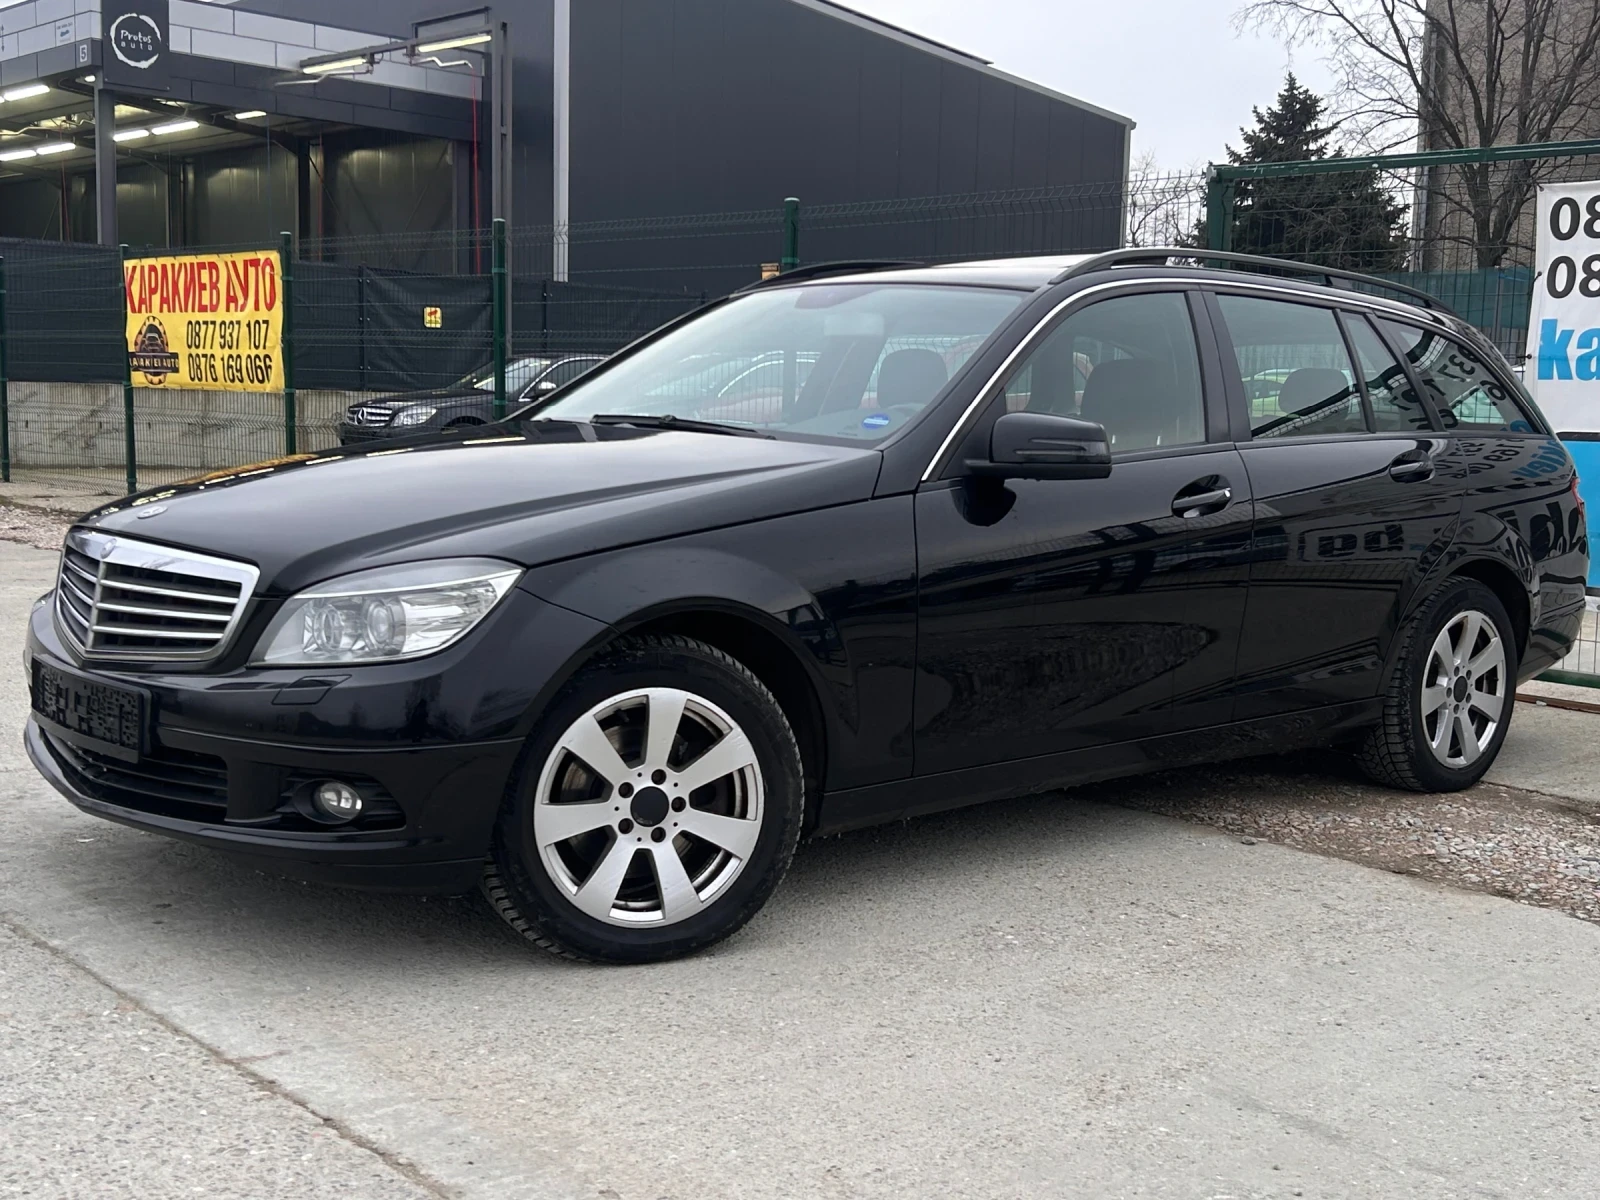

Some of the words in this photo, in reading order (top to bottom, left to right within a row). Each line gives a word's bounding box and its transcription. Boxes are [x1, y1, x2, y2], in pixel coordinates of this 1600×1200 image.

[120, 29, 152, 43] Protos
[120, 41, 153, 51] auto
[80, 46, 87, 60] 5
[125, 260, 221, 314] КАРАКИЕВ
[224, 257, 277, 313] АУТО
[186, 320, 217, 350] 0877
[219, 320, 241, 350] 937
[246, 319, 270, 350] 107
[1537, 318, 1600, 381] ka
[187, 353, 218, 383] 0876
[221, 353, 244, 384] 169
[246, 354, 272, 385] 066
